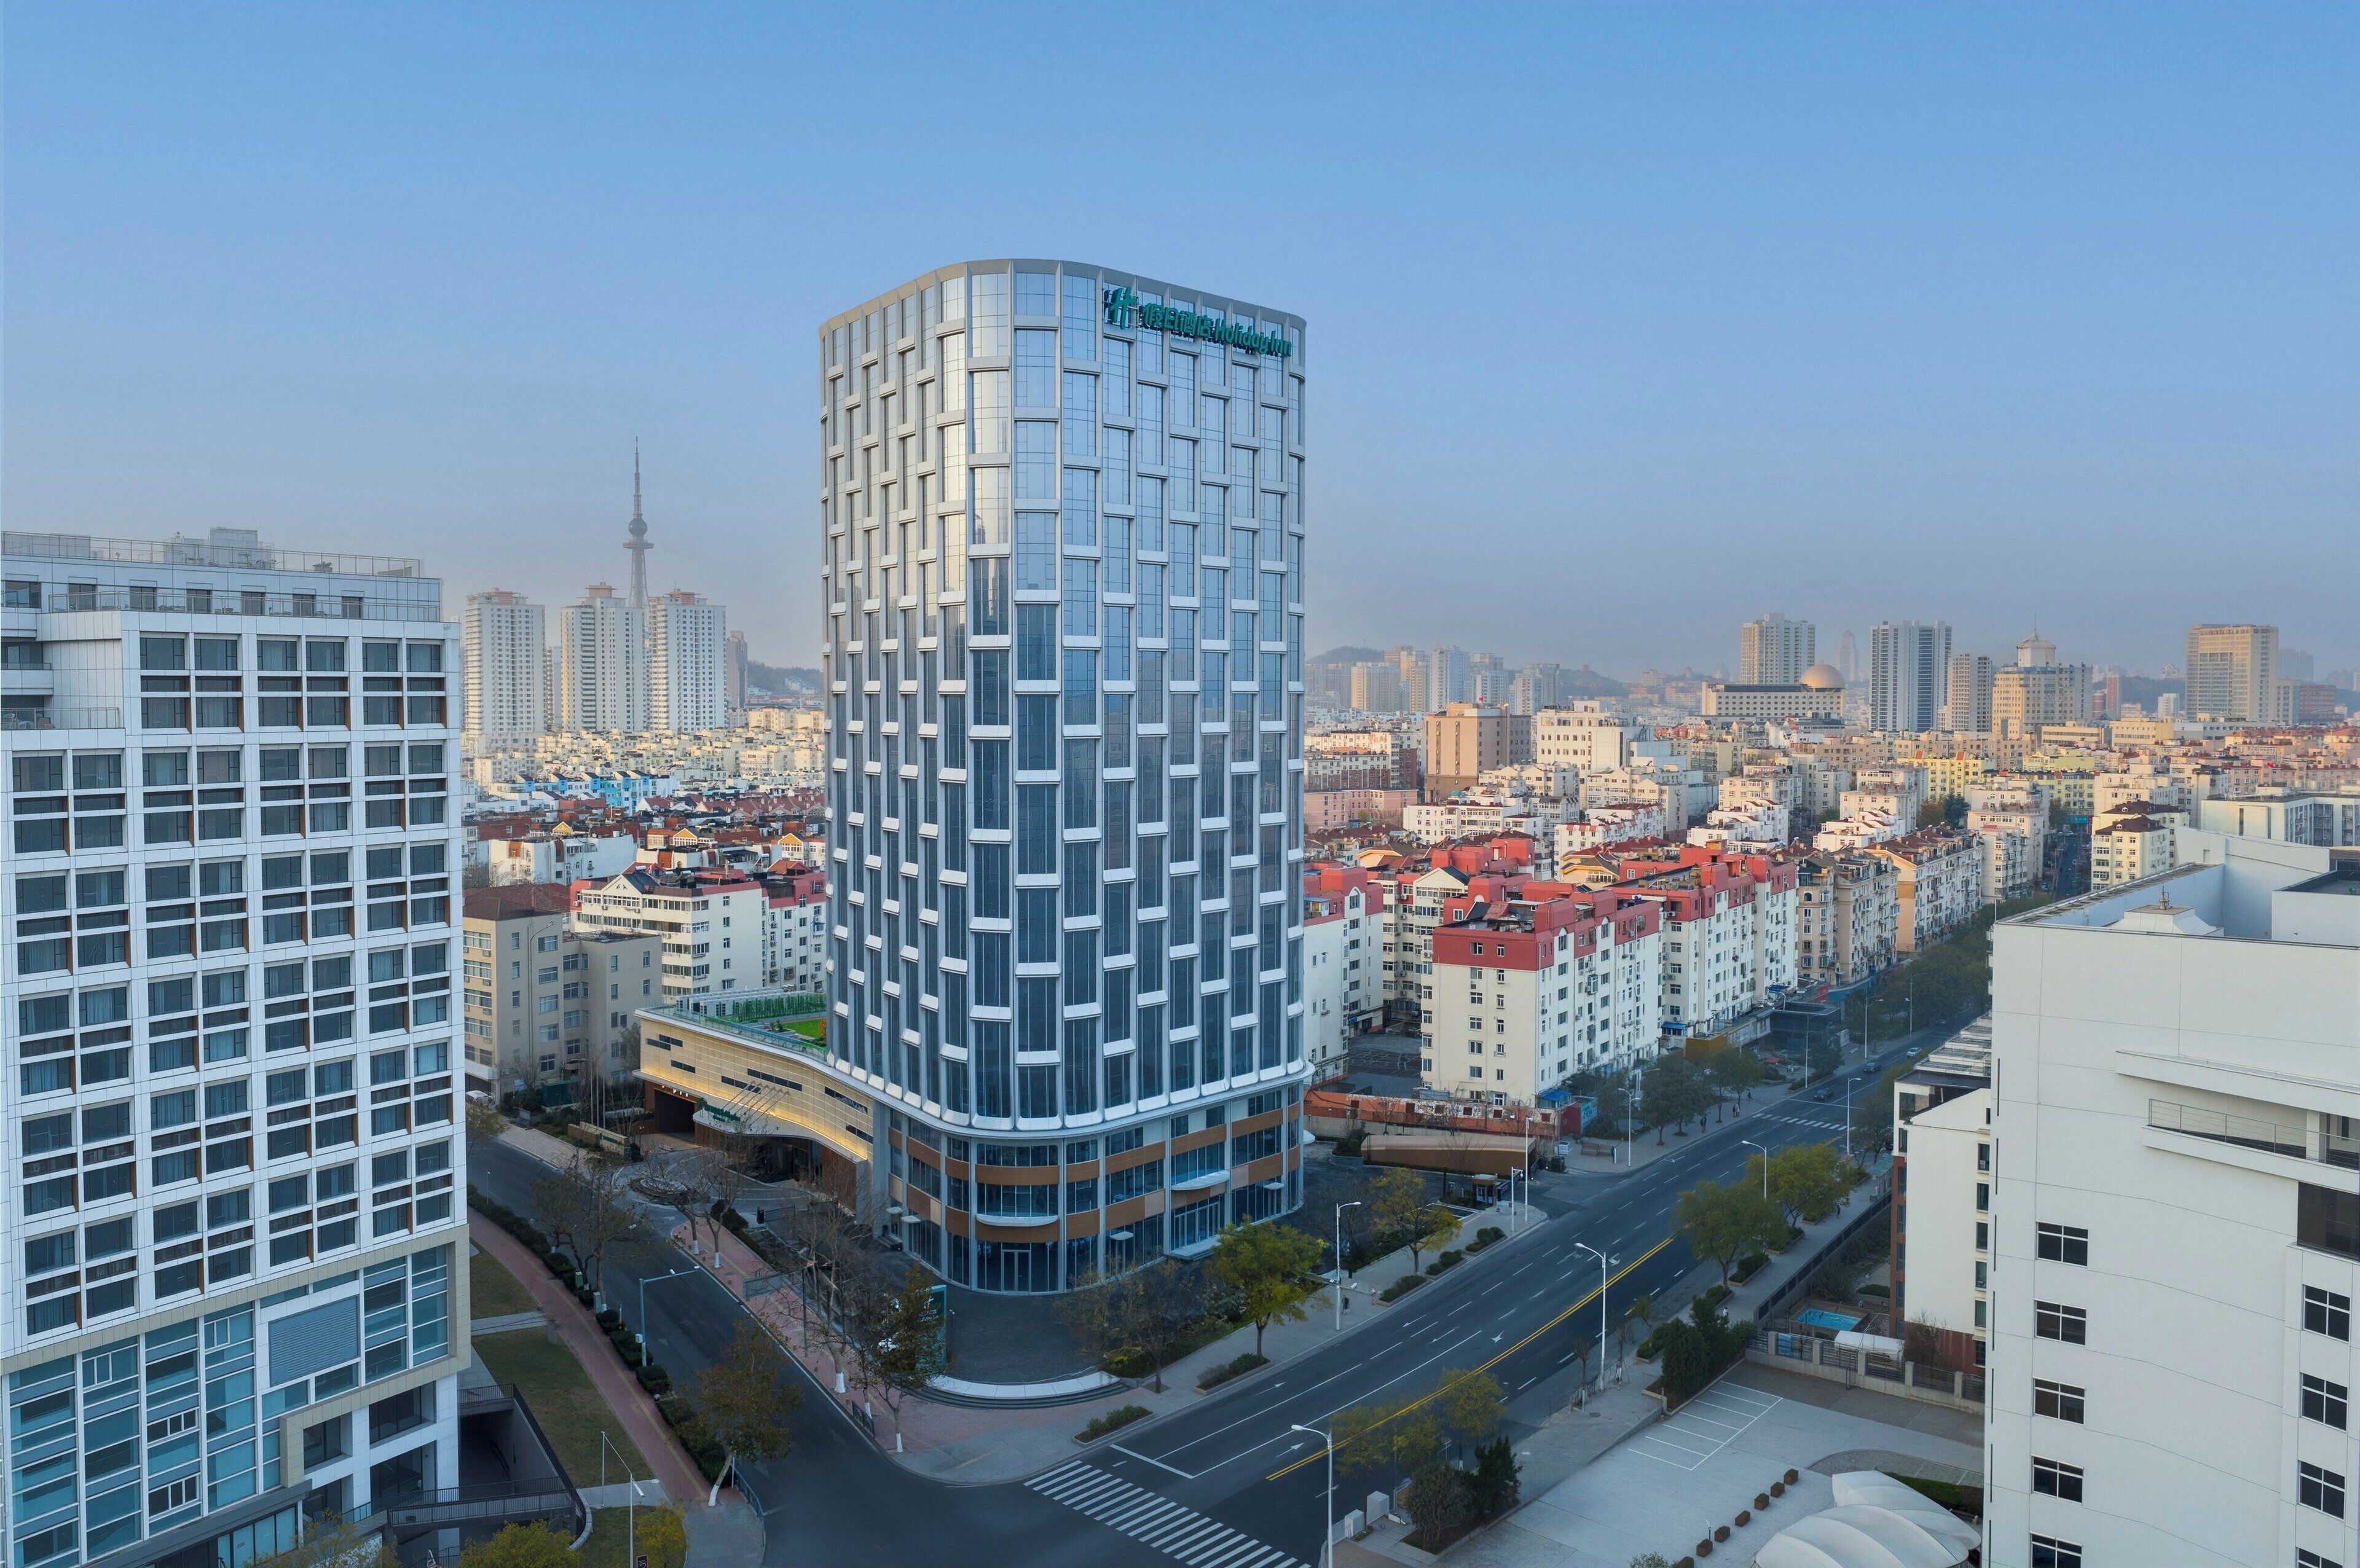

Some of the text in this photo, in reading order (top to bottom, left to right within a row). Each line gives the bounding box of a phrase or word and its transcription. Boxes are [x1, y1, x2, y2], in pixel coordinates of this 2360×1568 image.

[1143, 302, 1213, 338] 假日酒店
[1215, 318, 1292, 357] Holiday Inn
